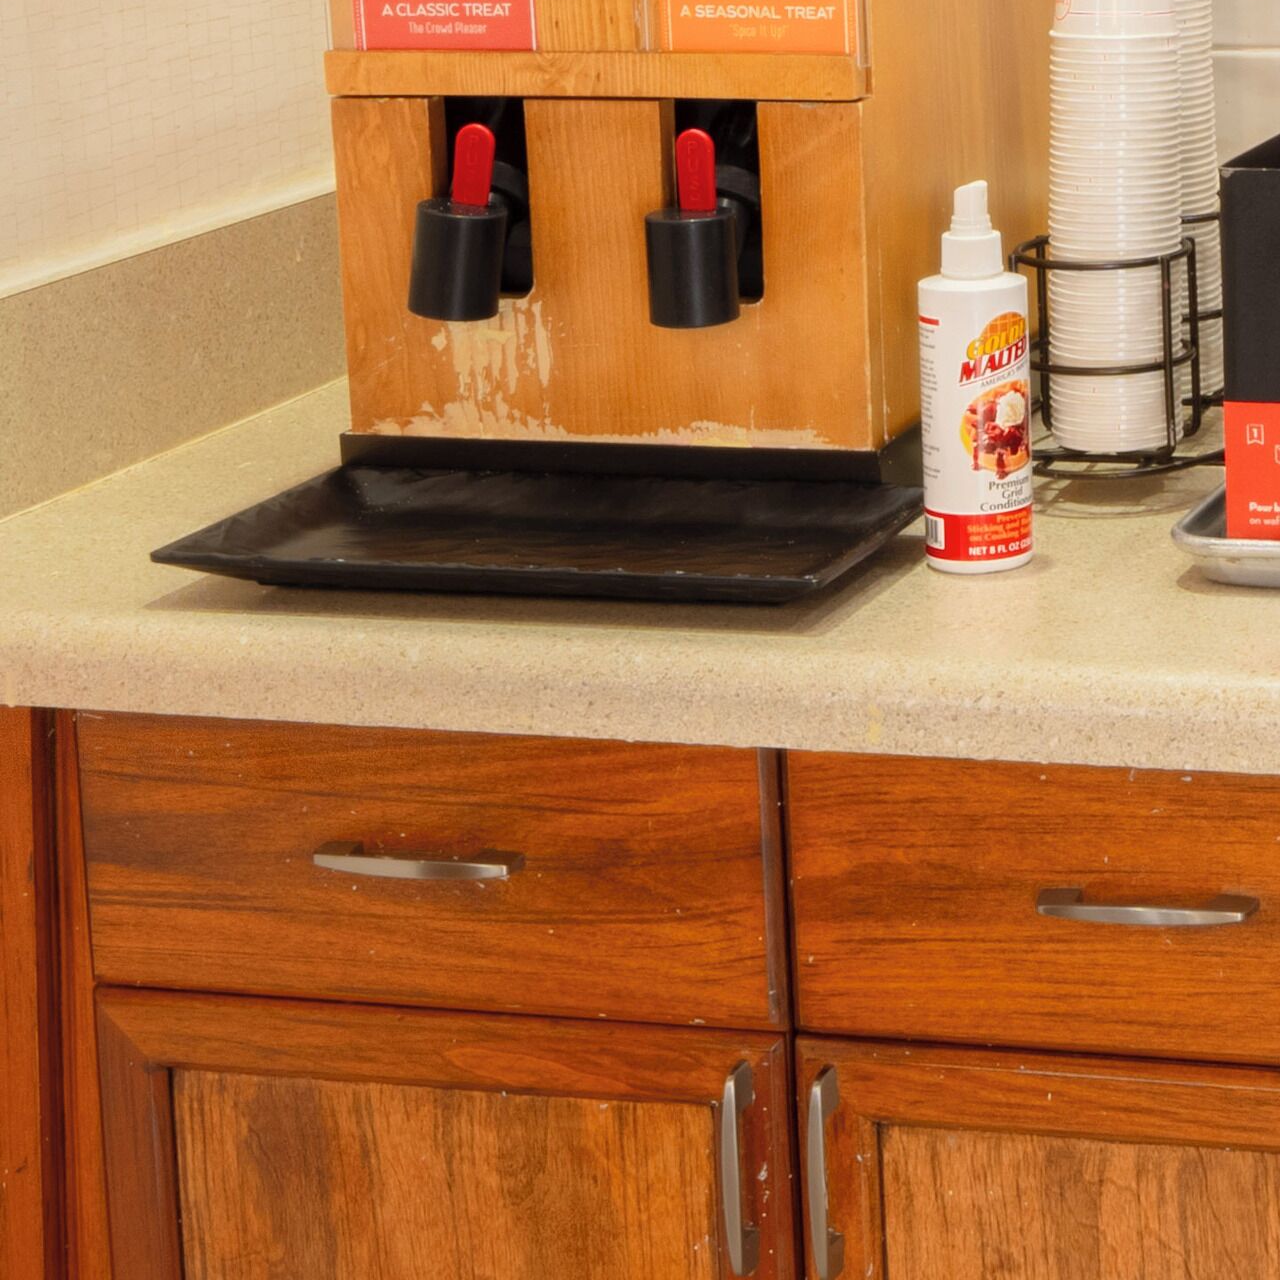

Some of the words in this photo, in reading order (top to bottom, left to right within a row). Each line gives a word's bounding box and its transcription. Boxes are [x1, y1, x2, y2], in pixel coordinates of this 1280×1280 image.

[382, 3, 394, 17] A
[396, 3, 459, 17] CLASSIC
[463, 3, 512, 17] TREAT
[680, 5, 692, 17] A
[694, 5, 782, 19] SEASONAL
[784, 6, 836, 20] TREAT
[408, 22, 424, 34] The
[425, 22, 453, 34] Crowd
[455, 22, 487, 34] Pleaser
[1002, 486, 1023, 499] Grid
[1249, 502, 1272, 512] Pour
[1249, 517, 1262, 525] on
[969, 546, 987, 556] NET
